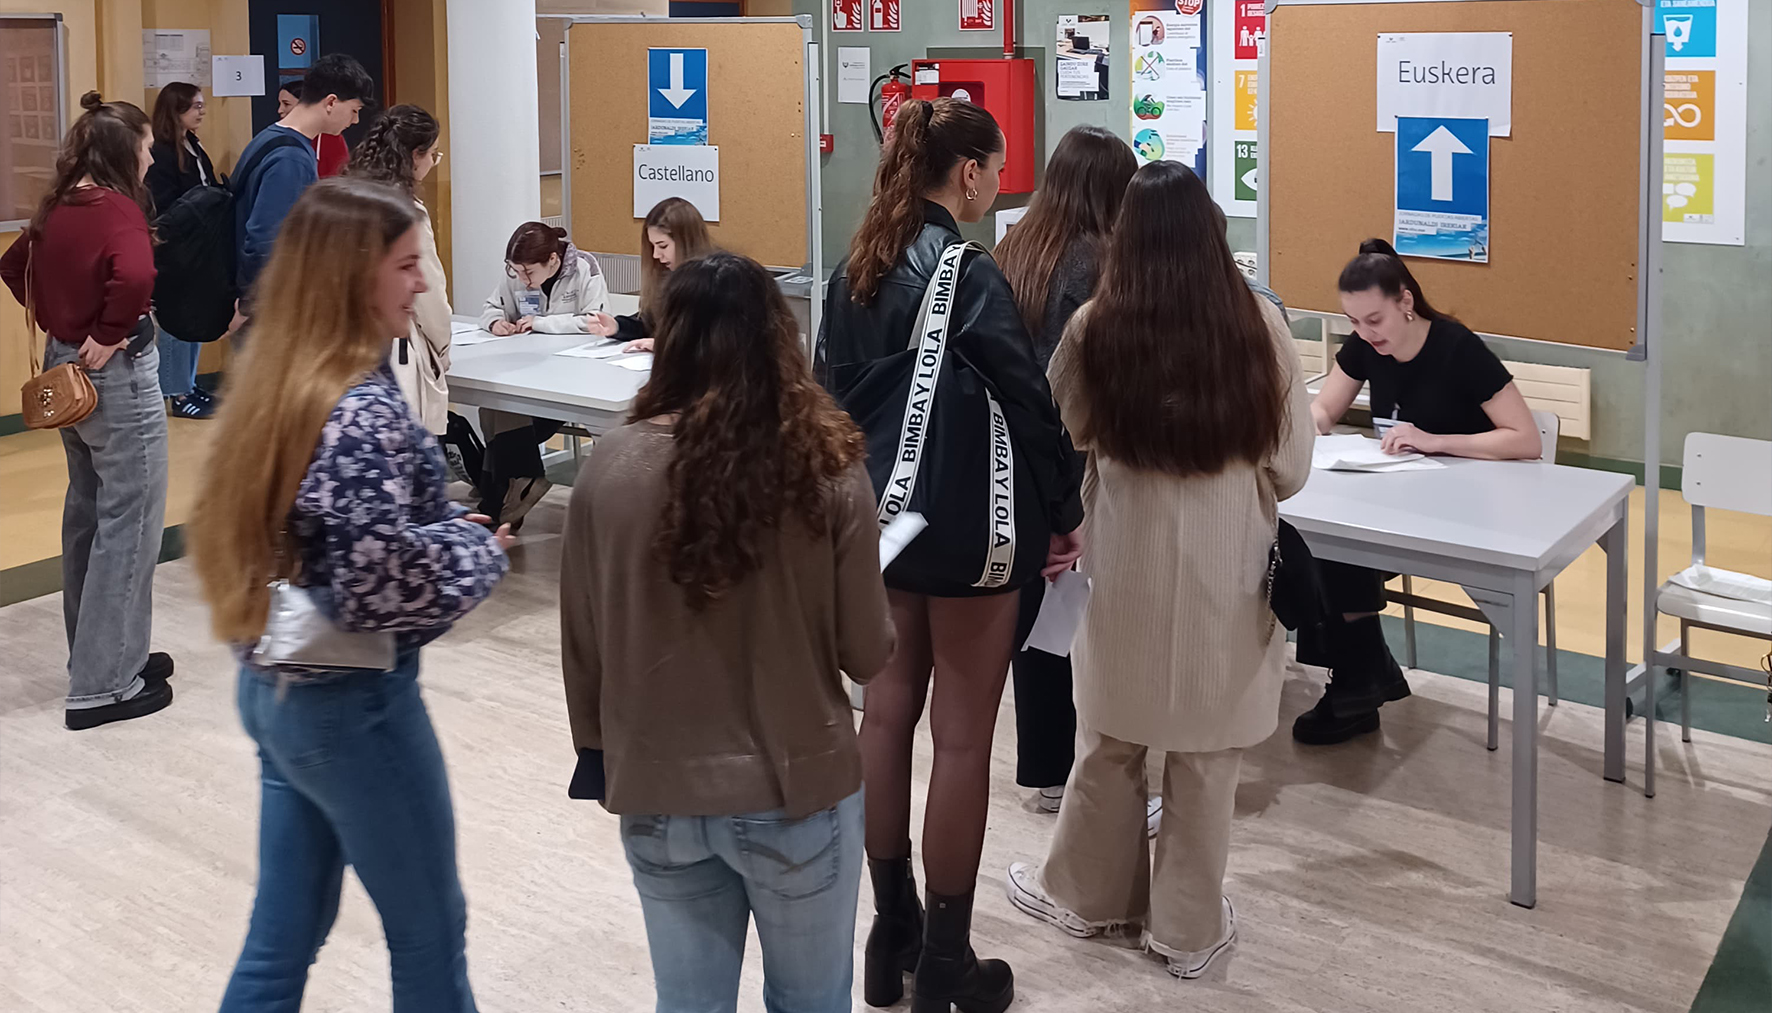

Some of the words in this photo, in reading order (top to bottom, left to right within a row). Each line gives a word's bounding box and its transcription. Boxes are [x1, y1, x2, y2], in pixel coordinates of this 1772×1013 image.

[1240, 4, 1246, 17] 1
[236, 71, 242, 81] 3
[1399, 60, 1495, 84] Euskera
[1239, 75, 1245, 88] 7
[1237, 145, 1248, 158] 13
[638, 164, 714, 182] Castellano
[919, 328, 942, 378] LOLA
[994, 493, 1011, 548] LOLA
